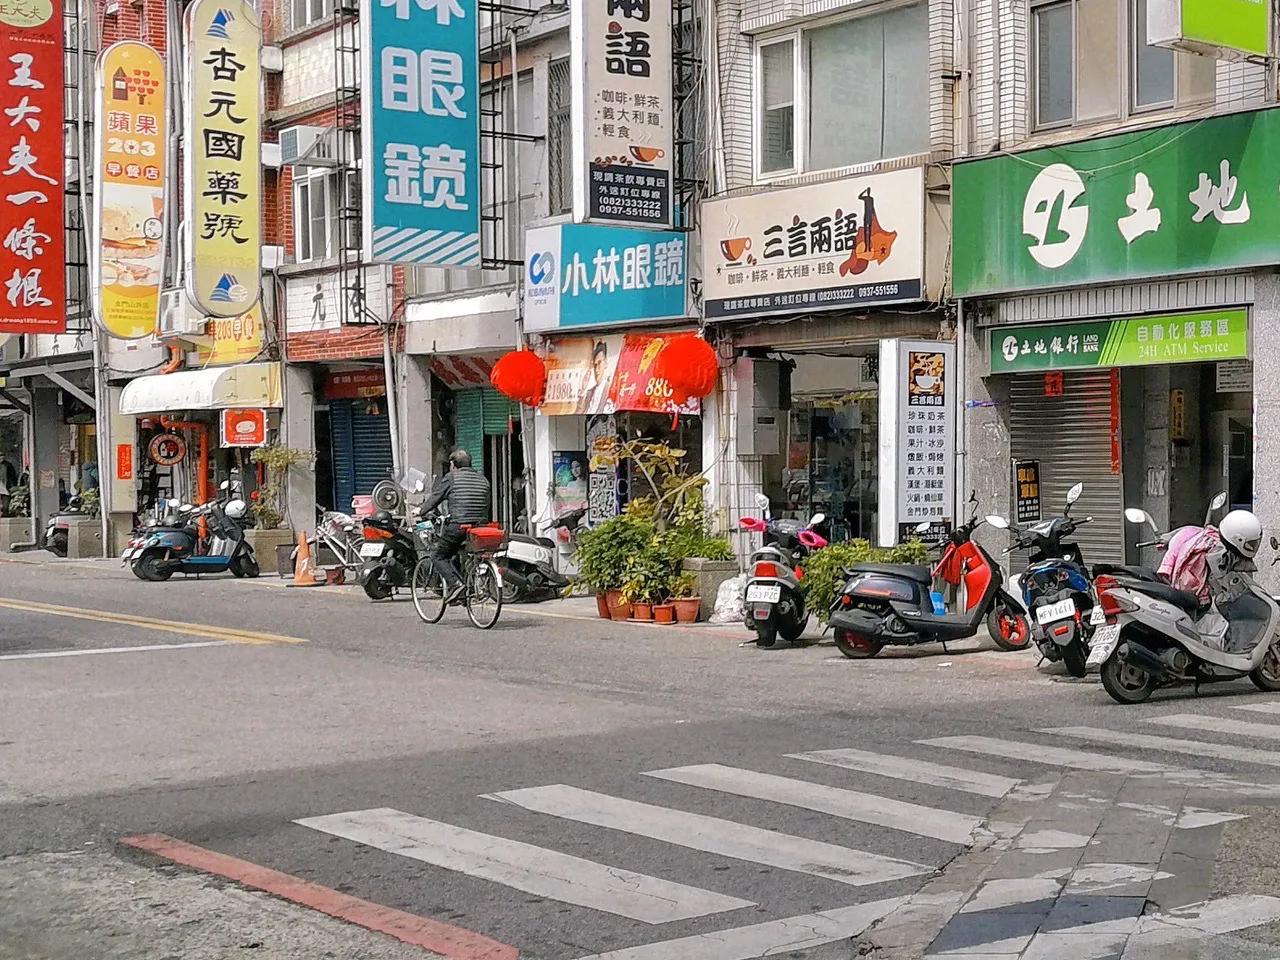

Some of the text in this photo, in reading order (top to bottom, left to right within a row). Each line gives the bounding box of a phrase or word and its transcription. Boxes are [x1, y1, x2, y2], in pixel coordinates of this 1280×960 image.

[107, 111, 159, 135] 蘋果
[602, 106, 660, 126] 義大利麵
[602, 123, 630, 139] 輕食
[107, 139, 157, 157] 203
[203, 47, 249, 243] 杏元國藥號
[107, 163, 159, 179] 早餐店
[3, 53, 60, 308] 王大夫一條根
[599, 197, 661, 209] (082)333222
[599, 206, 661, 218] 0937-551556
[763, 213, 858, 259] 三言兩語
[561, 240, 684, 297] 小林眼鏡
[817, 289, 855, 302] (082)333222
[858, 284, 899, 297] 0937-551556
[1082, 334, 1099, 343] LAND
[1138, 319, 1230, 341] 自動化服務區
[1021, 335, 1079, 355] 土地銀行
[1083, 343, 1099, 352] BANK
[1139, 339, 1229, 358] 24H ATM Service
[908, 411, 944, 420] 珍珠奶茶
[907, 466, 944, 475] 義大利麵
